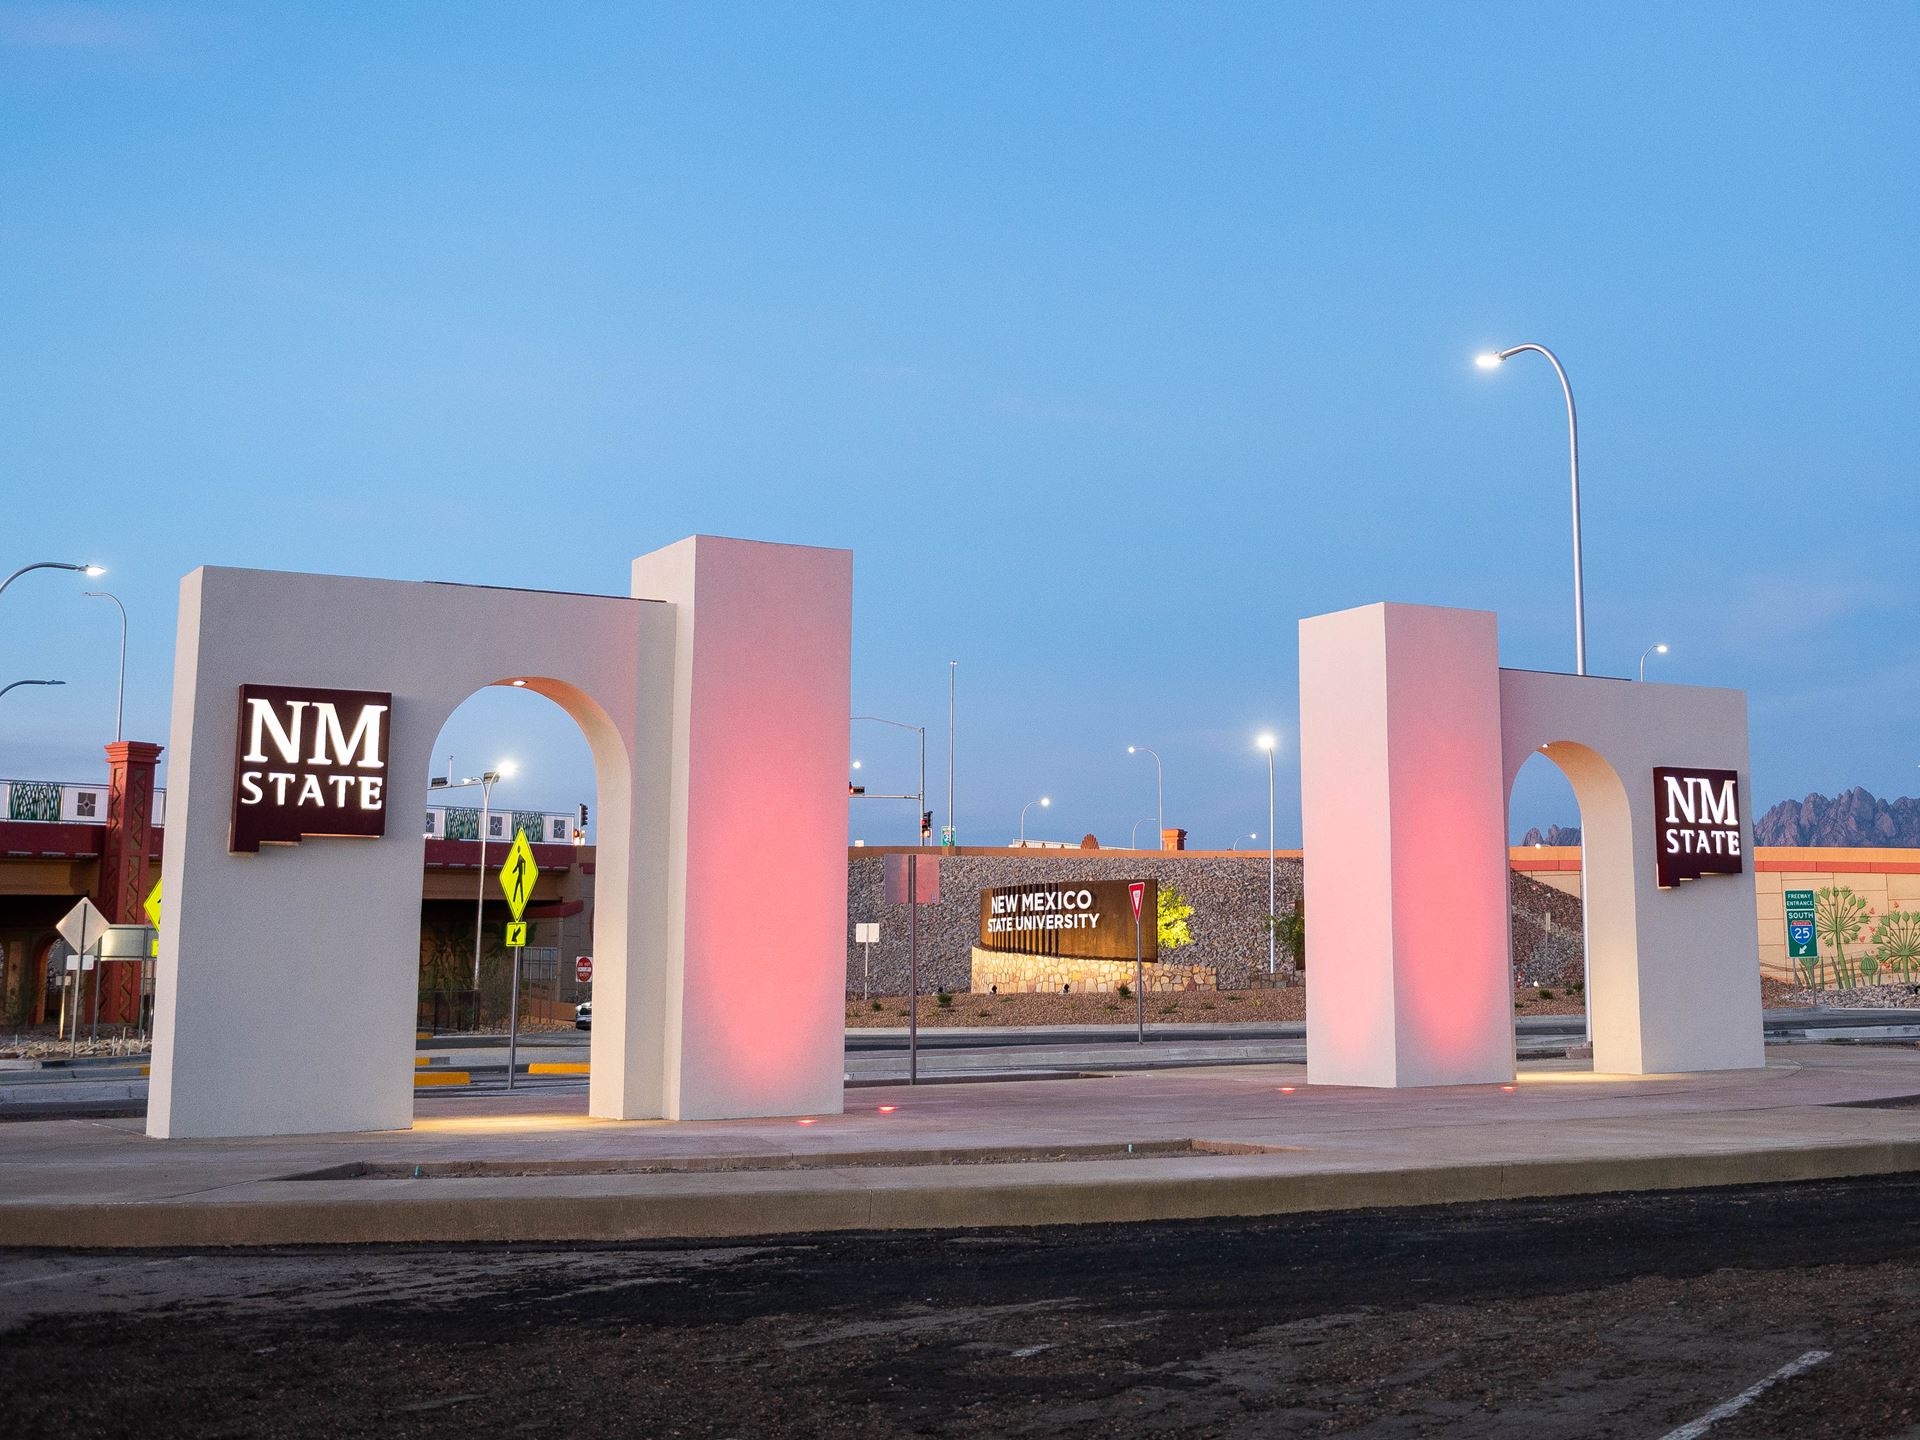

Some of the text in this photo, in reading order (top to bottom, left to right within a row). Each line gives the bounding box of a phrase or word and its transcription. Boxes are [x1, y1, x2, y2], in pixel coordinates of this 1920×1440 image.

[243, 698, 388, 769] NM
[241, 771, 383, 810] STATE
[1663, 776, 1739, 825] NM
[1665, 828, 1741, 856] STATE
[991, 889, 1092, 914] NEW MEXICO
[987, 913, 1101, 933] STATE UNIVERSITY
[1794, 927, 1810, 939] 25
